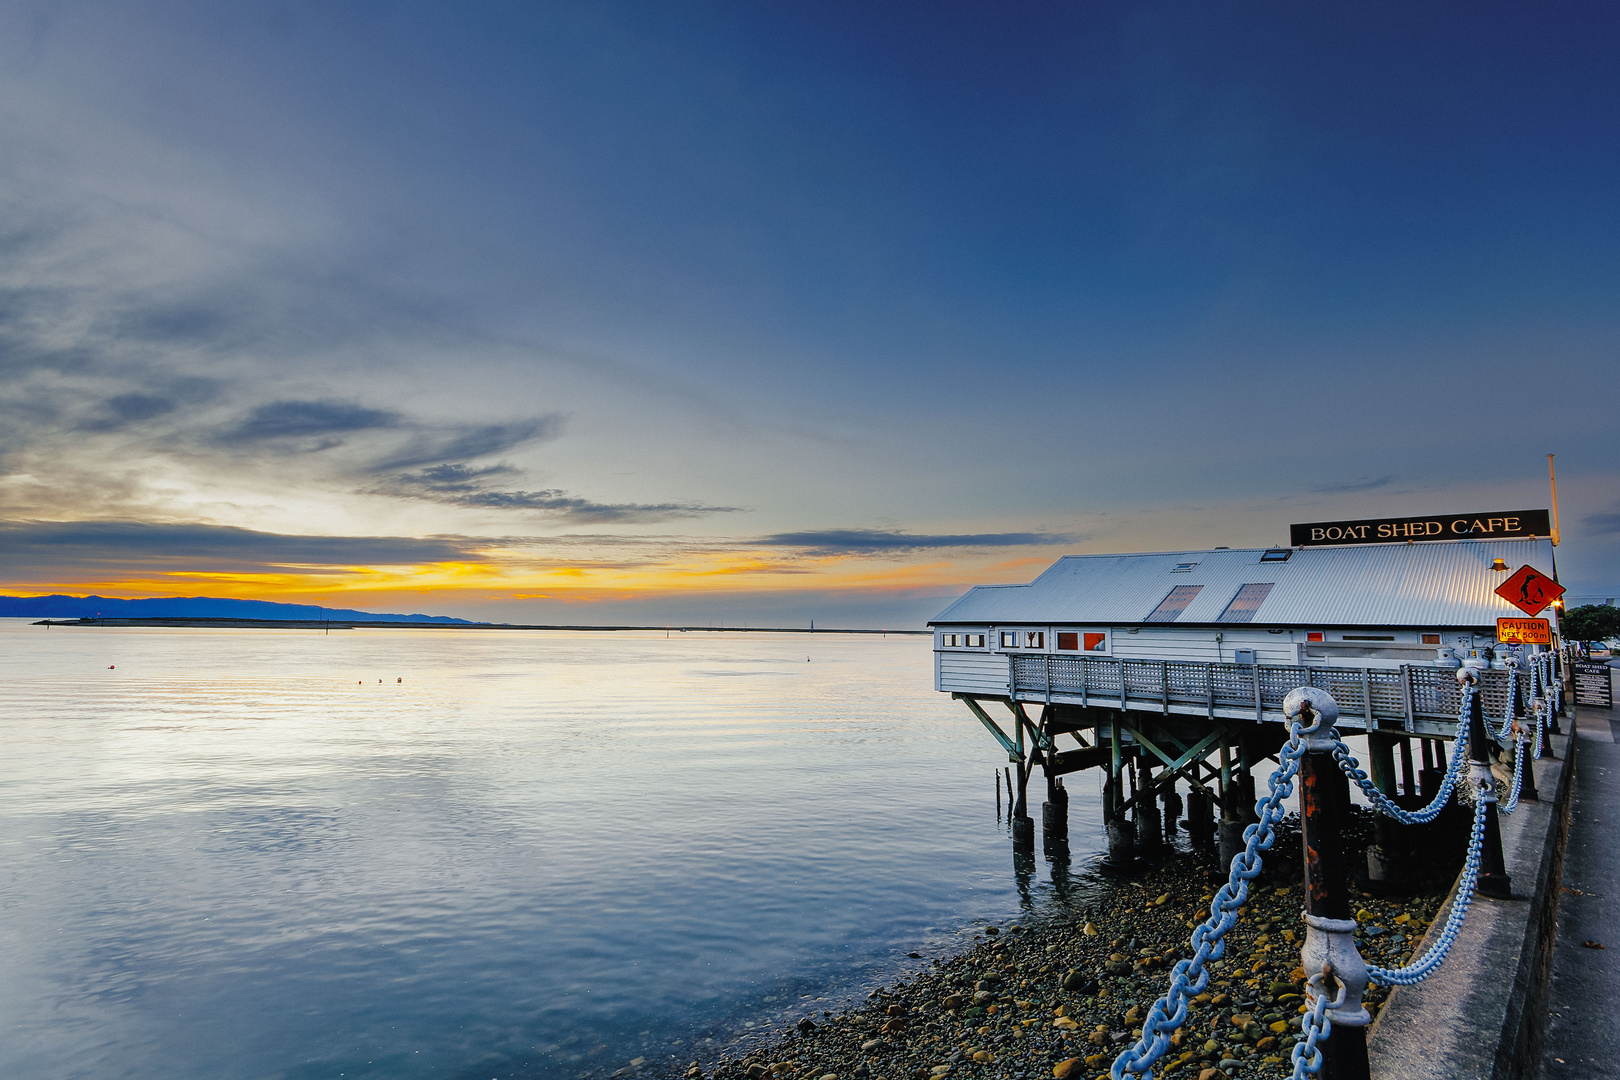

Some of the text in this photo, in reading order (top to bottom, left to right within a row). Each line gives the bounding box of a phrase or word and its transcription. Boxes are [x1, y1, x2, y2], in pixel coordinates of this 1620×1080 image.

[1310, 517, 1522, 541] BOAT SHED CAFE
[1502, 622, 1544, 630] CAUTION
